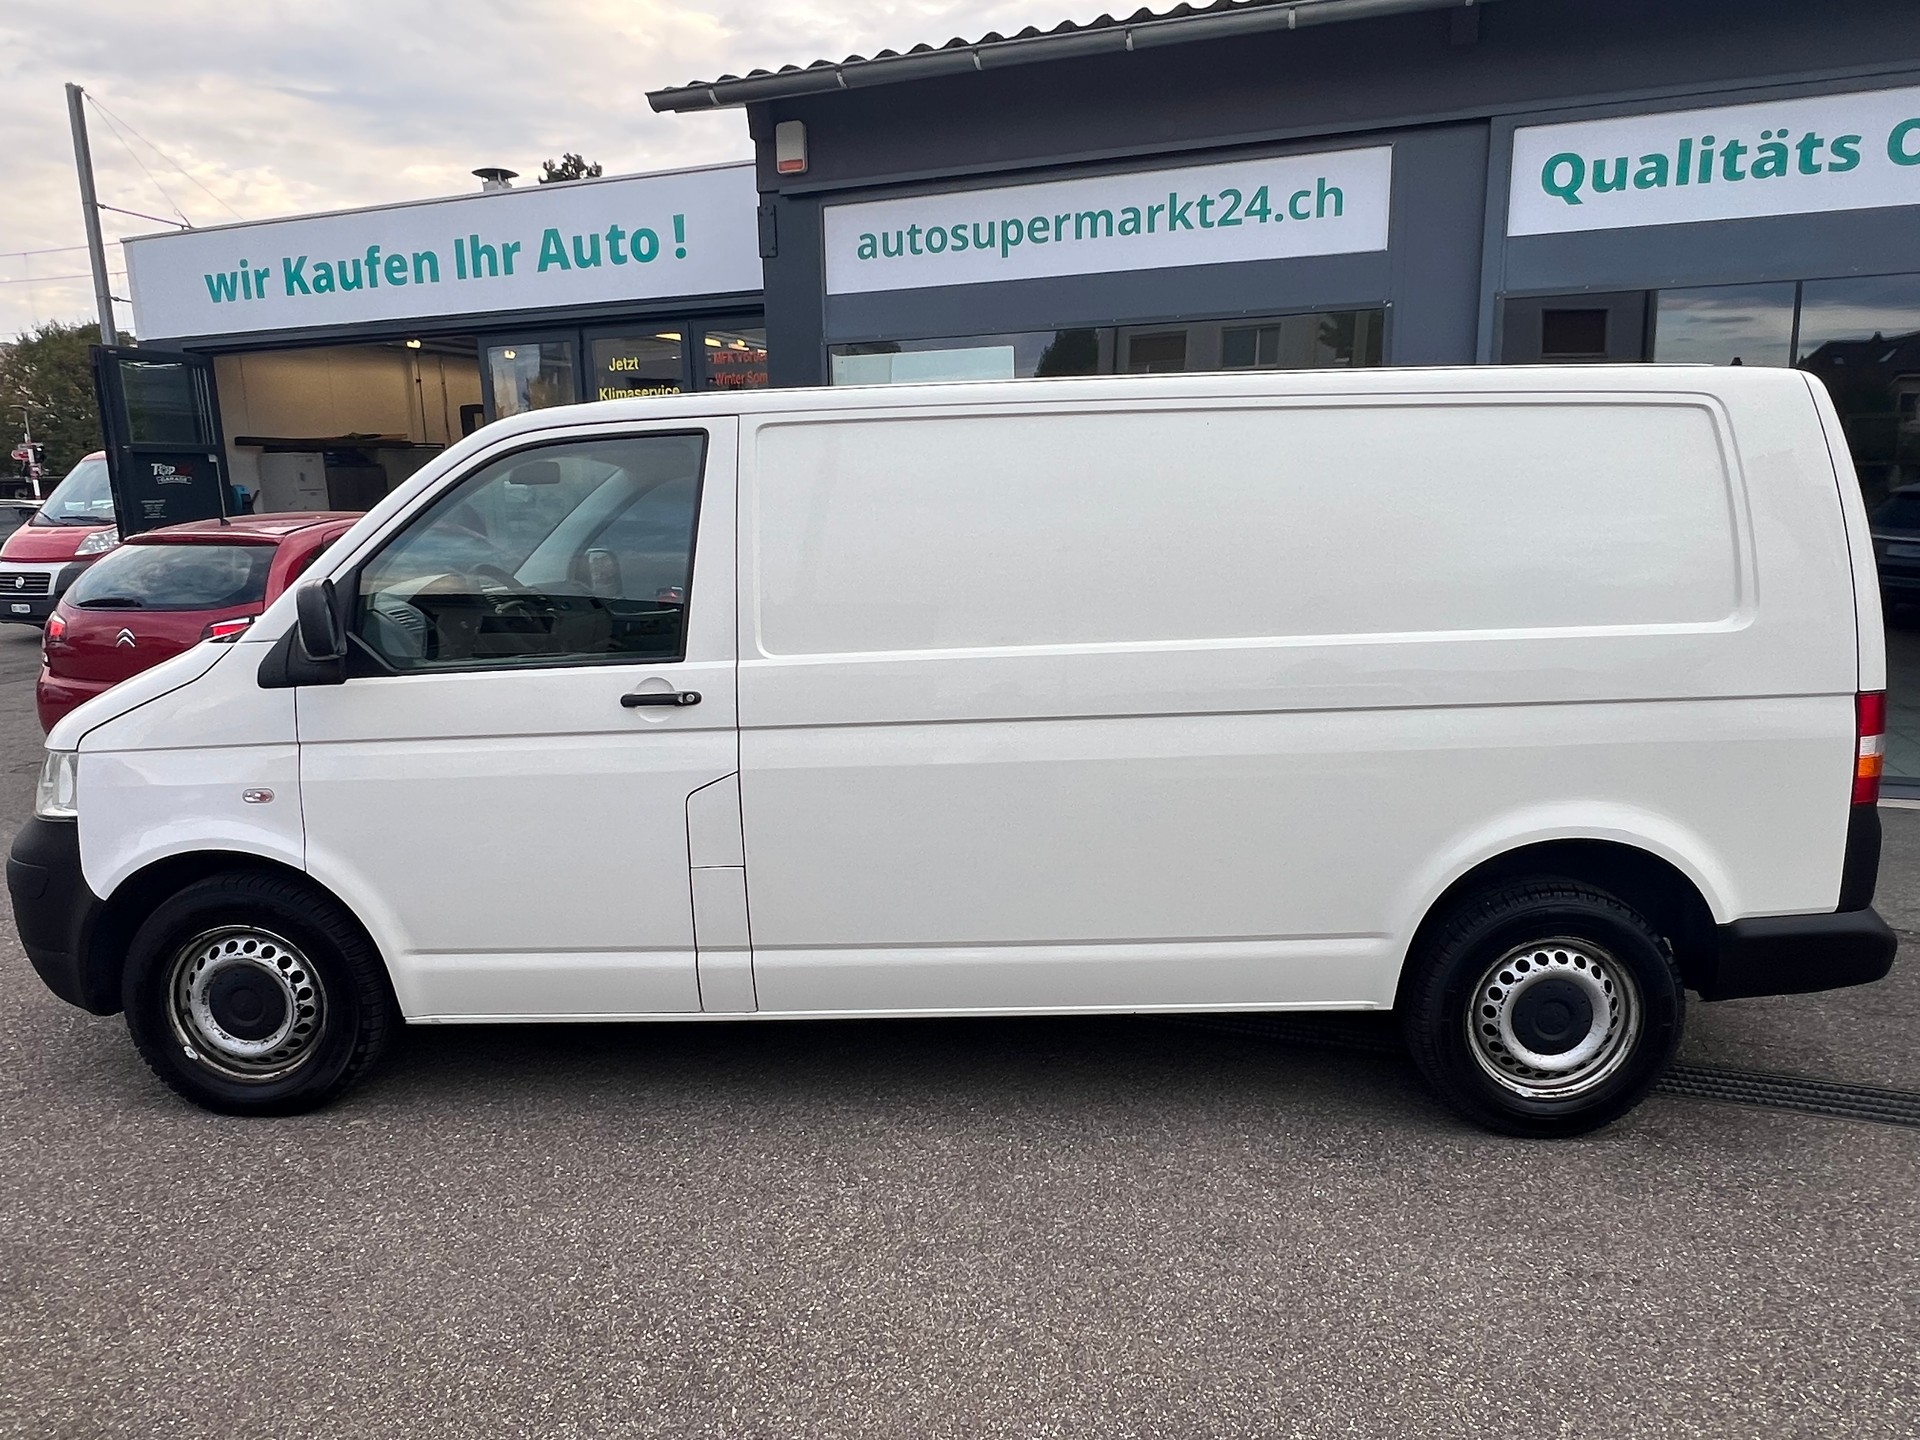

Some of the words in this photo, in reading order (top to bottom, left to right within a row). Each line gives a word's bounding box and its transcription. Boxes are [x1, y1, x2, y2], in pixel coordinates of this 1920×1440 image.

[1541, 129, 1861, 205] Qualitäts
[857, 177, 1344, 260] autosupermarkt24.ch
[204, 258, 271, 304] wir
[283, 244, 440, 297] Kaufen
[454, 233, 522, 280] Ihr
[537, 223, 661, 273] Auto
[608, 357, 640, 372] Jetzt
[715, 371, 745, 386] Winter
[598, 385, 681, 401] Klimaservice
